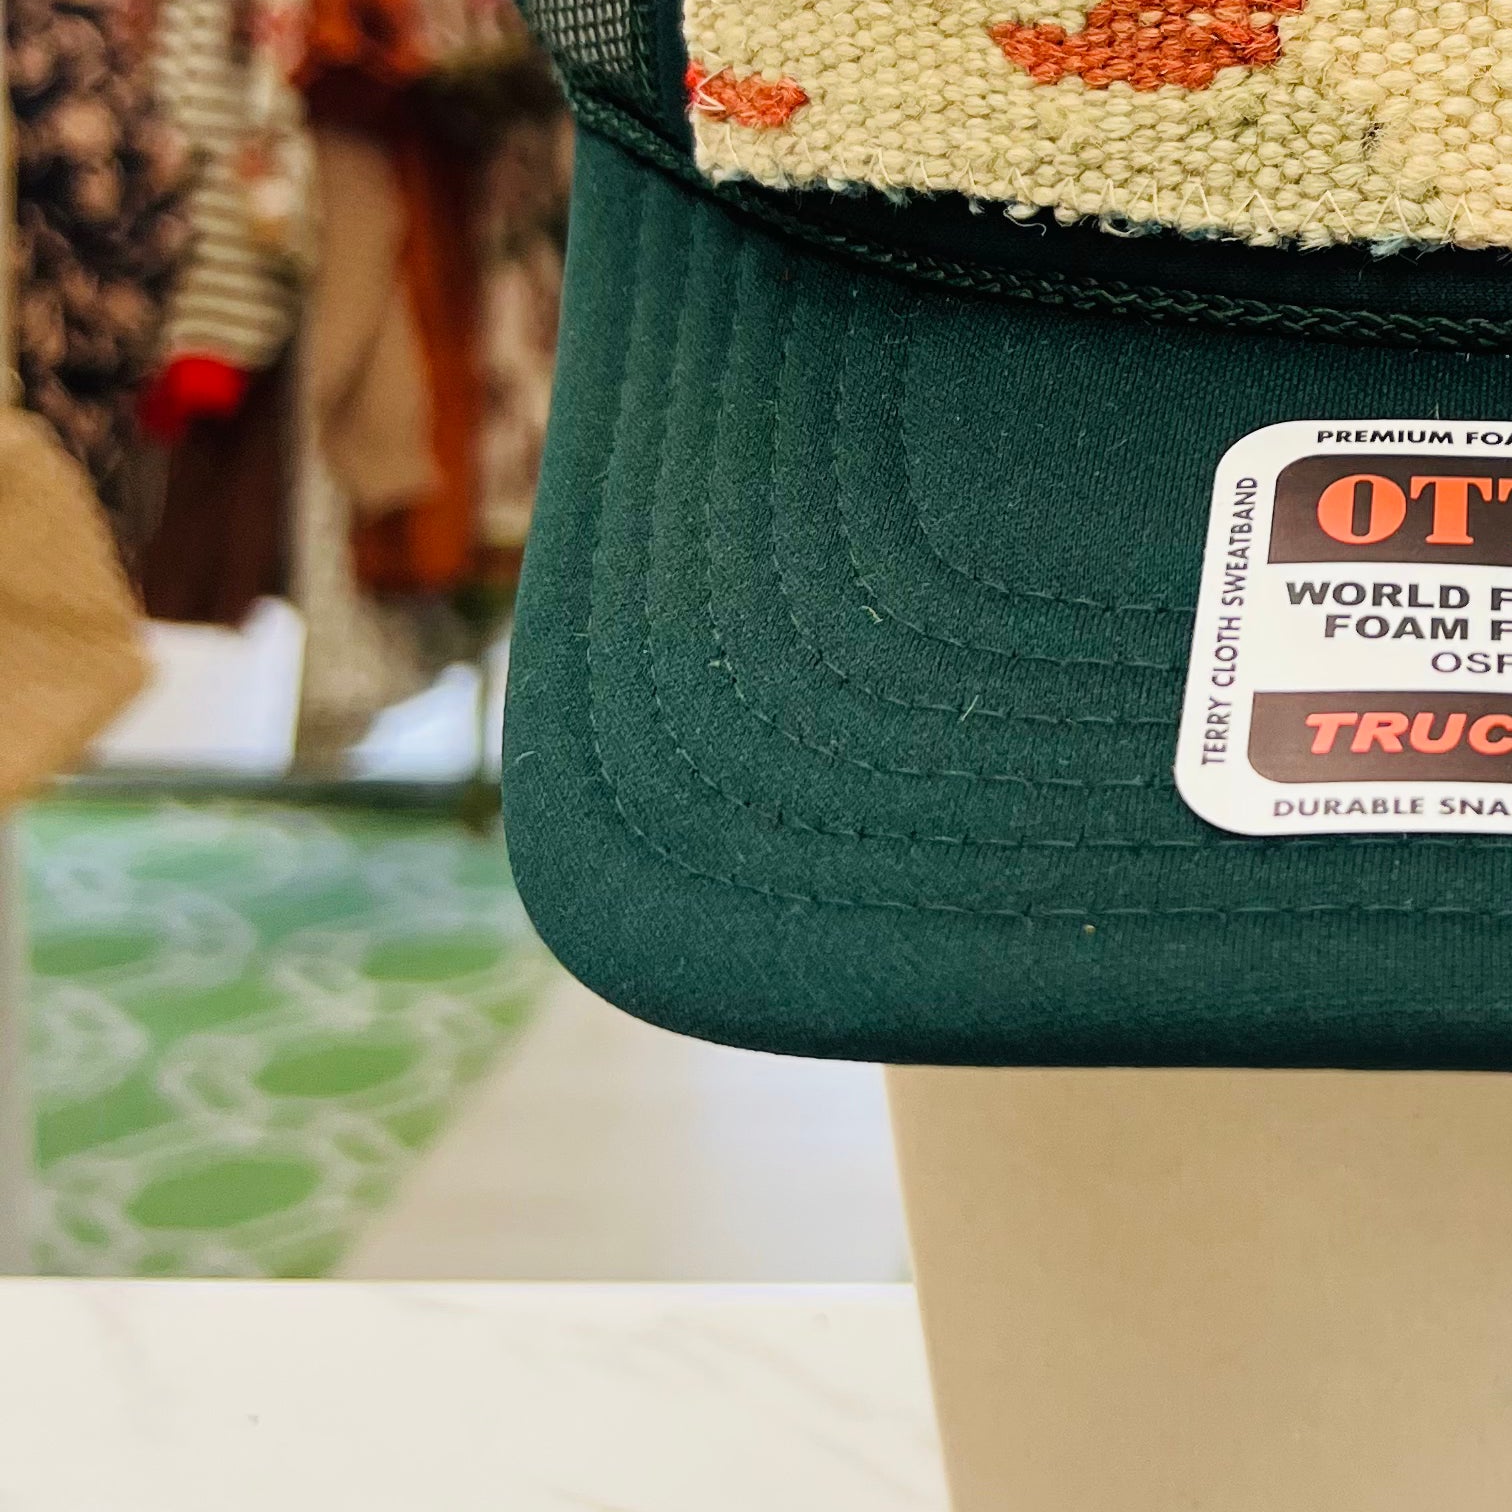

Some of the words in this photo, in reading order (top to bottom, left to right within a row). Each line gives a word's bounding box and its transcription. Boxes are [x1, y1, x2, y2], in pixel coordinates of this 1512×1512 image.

[1317, 430, 1454, 445] PREMIUM
[1221, 477, 1258, 606] SWEATBAND
[1286, 581, 1470, 609] WORLD
[1324, 614, 1469, 641] FOAM
[1211, 617, 1241, 687] CLOTH
[1201, 696, 1232, 765] TERRY
[1273, 798, 1424, 817] DURABLE
